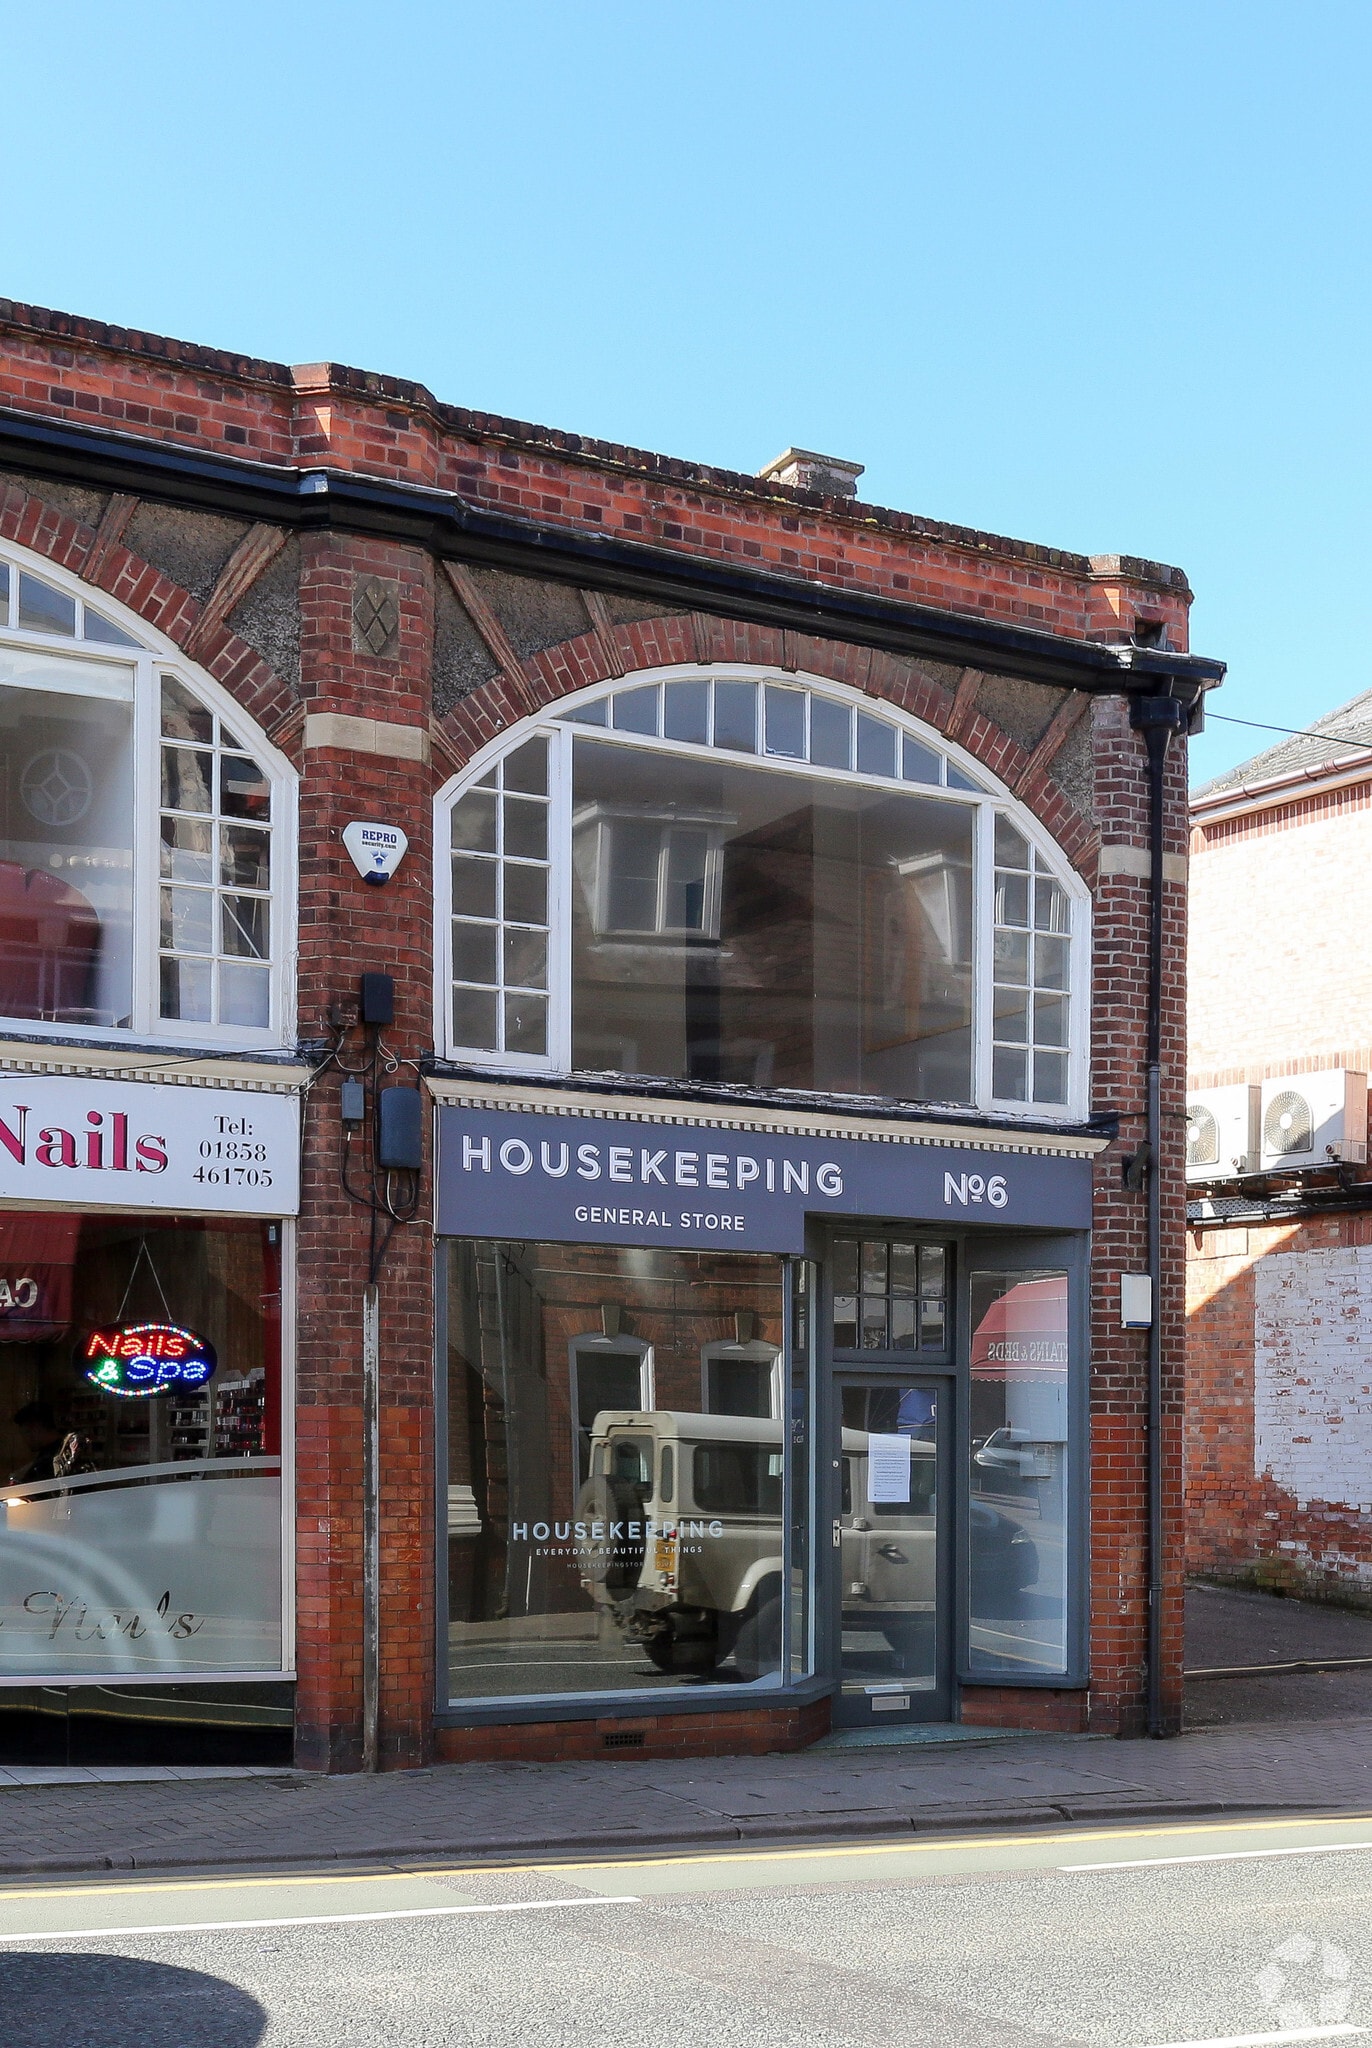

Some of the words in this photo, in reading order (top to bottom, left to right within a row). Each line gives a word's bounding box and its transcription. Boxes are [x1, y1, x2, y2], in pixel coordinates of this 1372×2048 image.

[362, 830, 397, 843] REPRO
[362, 841, 397, 849] security.com
[213, 1115, 253, 1136] Tel:
[0, 1105, 168, 1174] Nails
[199, 1140, 267, 1162] 01858
[192, 1166, 273, 1188] 461705
[462, 1135, 843, 1197] HOUSEKEEPING
[574, 1206, 672, 1229] GENERAL
[680, 1212, 746, 1232] STORE
[87, 1334, 185, 1356] Nails
[98, 1360, 119, 1380] &
[126, 1355, 207, 1384] Spa
[512, 1520, 724, 1541] HOUSEKEEPING
[535, 1547, 592, 1556] EVERYDAY
[598, 1546, 659, 1556] BEAUTIFUL
[664, 1545, 703, 1554] THINGS
